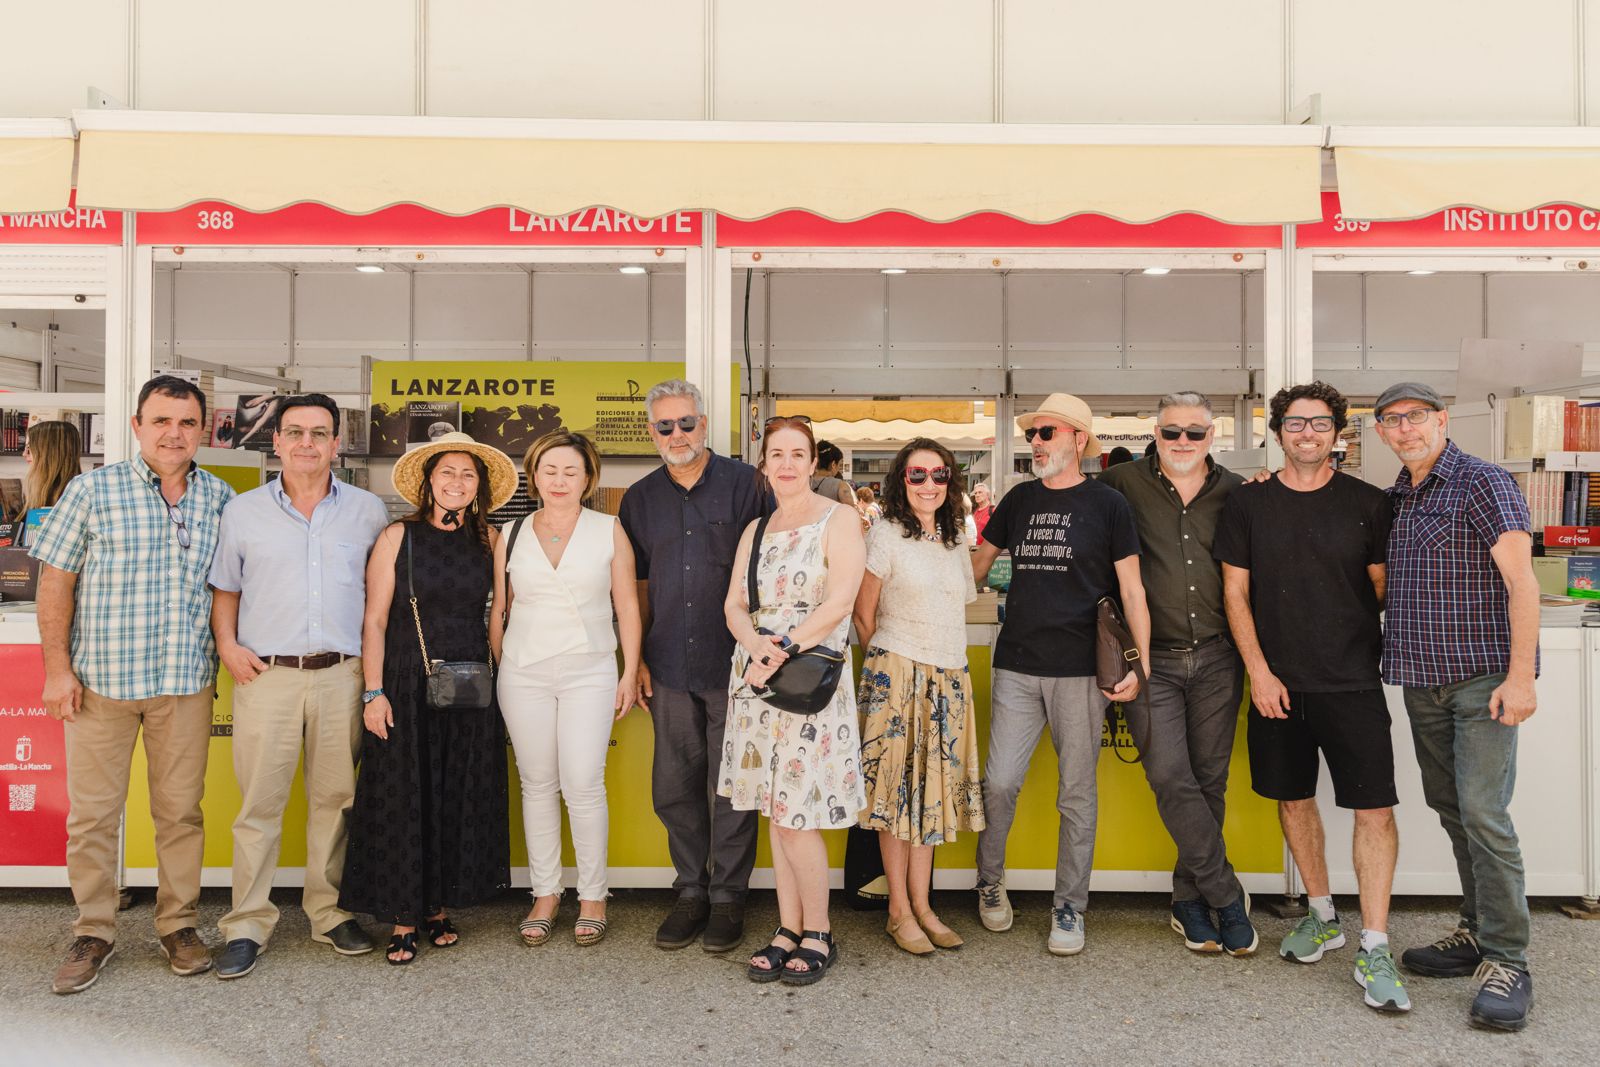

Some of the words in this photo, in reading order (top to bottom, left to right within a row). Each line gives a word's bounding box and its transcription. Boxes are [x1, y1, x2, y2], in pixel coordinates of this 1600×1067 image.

[10, 207, 106, 229] MANCHA
[198, 211, 234, 229] 368
[509, 207, 692, 232] LANZAROTE
[1444, 209, 1572, 231] INSTITUTO
[1579, 209, 1600, 231] C
[391, 379, 555, 396] LANZAROTE
[1029, 514, 1035, 525] a
[1036, 513, 1061, 525] versos
[1026, 528, 1032, 540] a
[1054, 529, 1067, 542] no,
[1015, 544, 1020, 557] a
[1021, 541, 1042, 557] besos
[1042, 543, 1073, 560] siempre.
